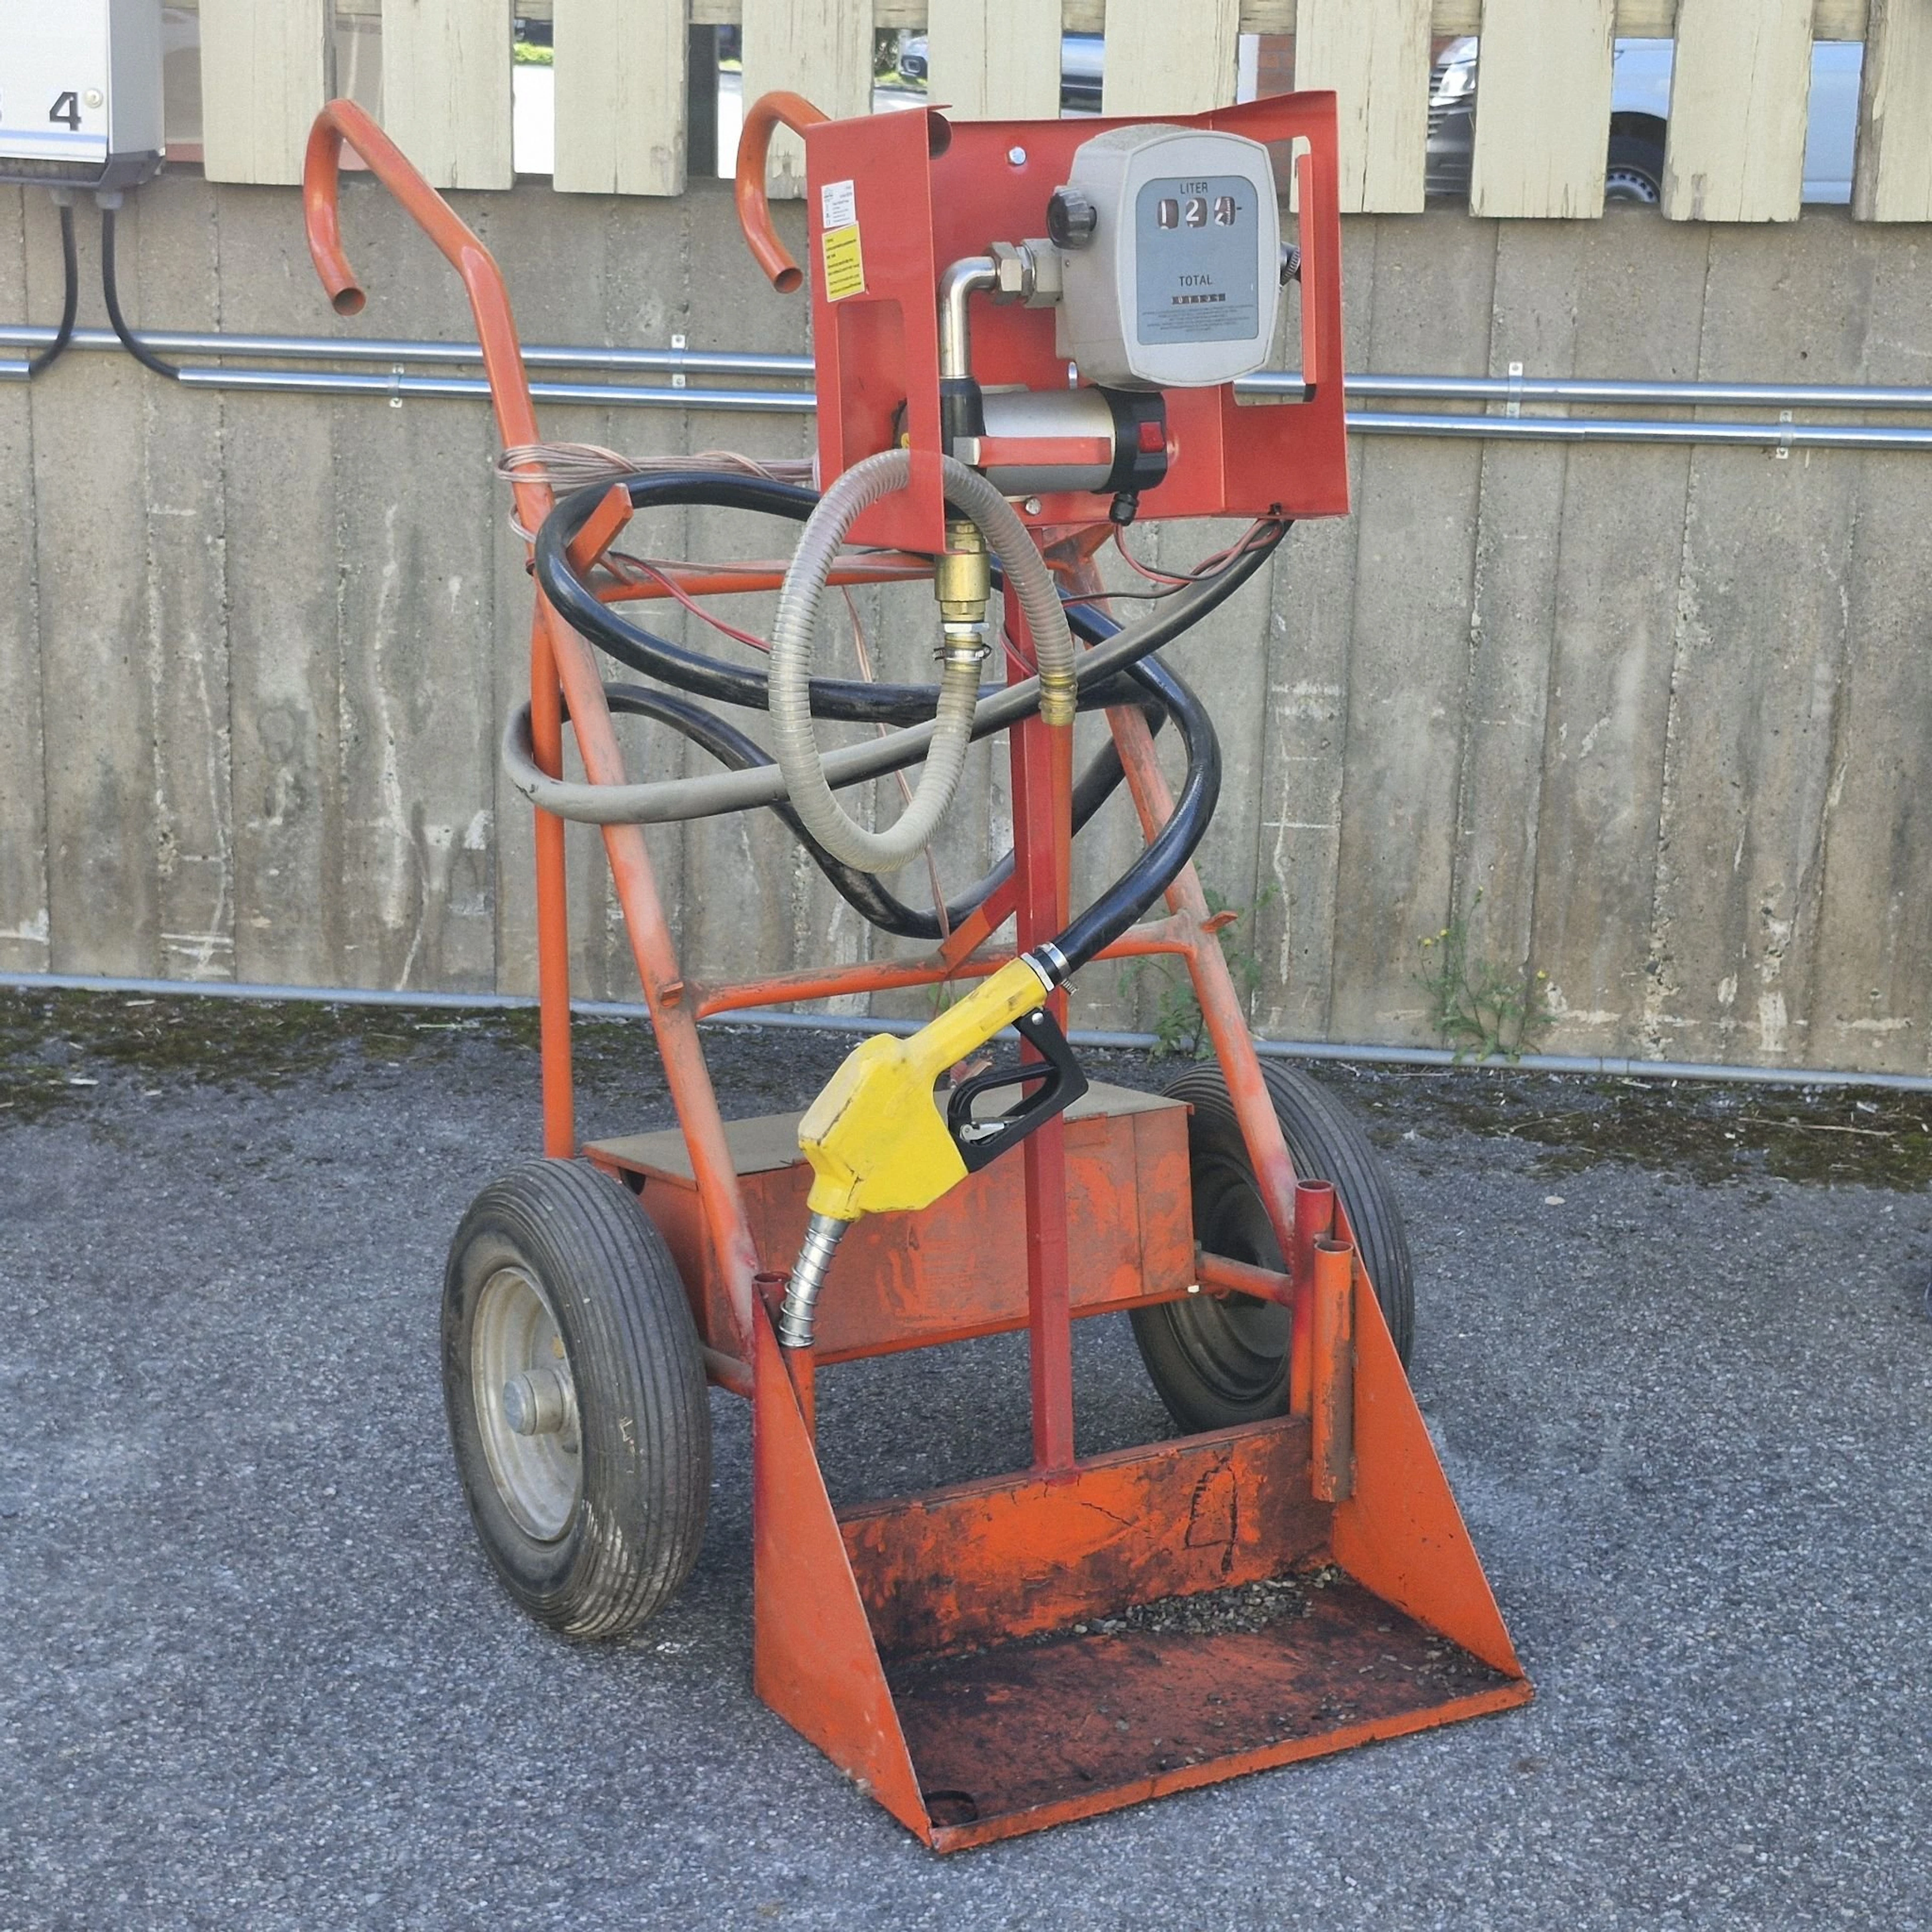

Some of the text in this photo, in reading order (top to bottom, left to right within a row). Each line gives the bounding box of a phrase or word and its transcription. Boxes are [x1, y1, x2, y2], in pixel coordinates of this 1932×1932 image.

[49, 91, 82, 131] 4
[1180, 182, 1208, 194] LITER
[1179, 275, 1212, 287] TOTAL
